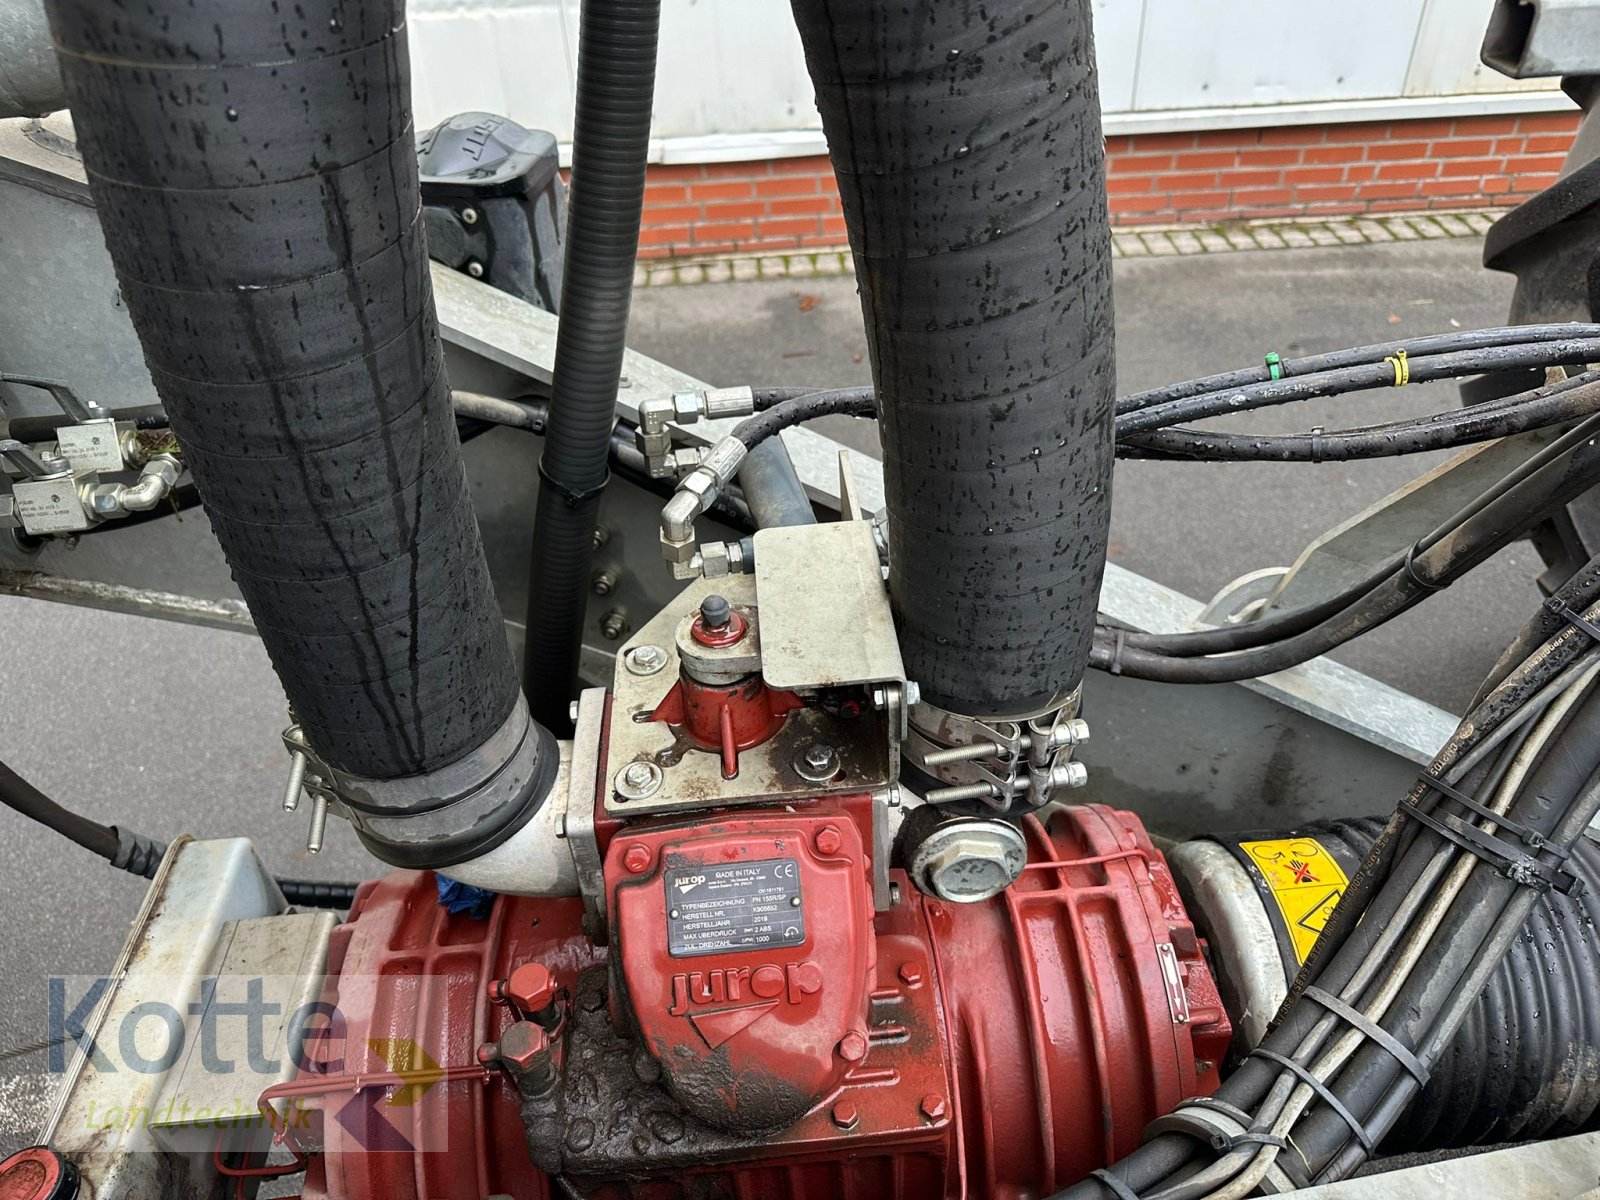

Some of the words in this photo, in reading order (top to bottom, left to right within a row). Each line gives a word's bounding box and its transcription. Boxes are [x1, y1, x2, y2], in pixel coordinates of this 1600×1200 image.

[715, 871, 735, 879] MADE
[735, 869, 743, 877] IN
[743, 868, 761, 876] ITALY
[674, 874, 706, 887] jurop
[681, 898, 746, 911] TYPENBEZEICHNUNG
[682, 911, 714, 921] HERSTELL
[670, 960, 823, 1016] jurop
